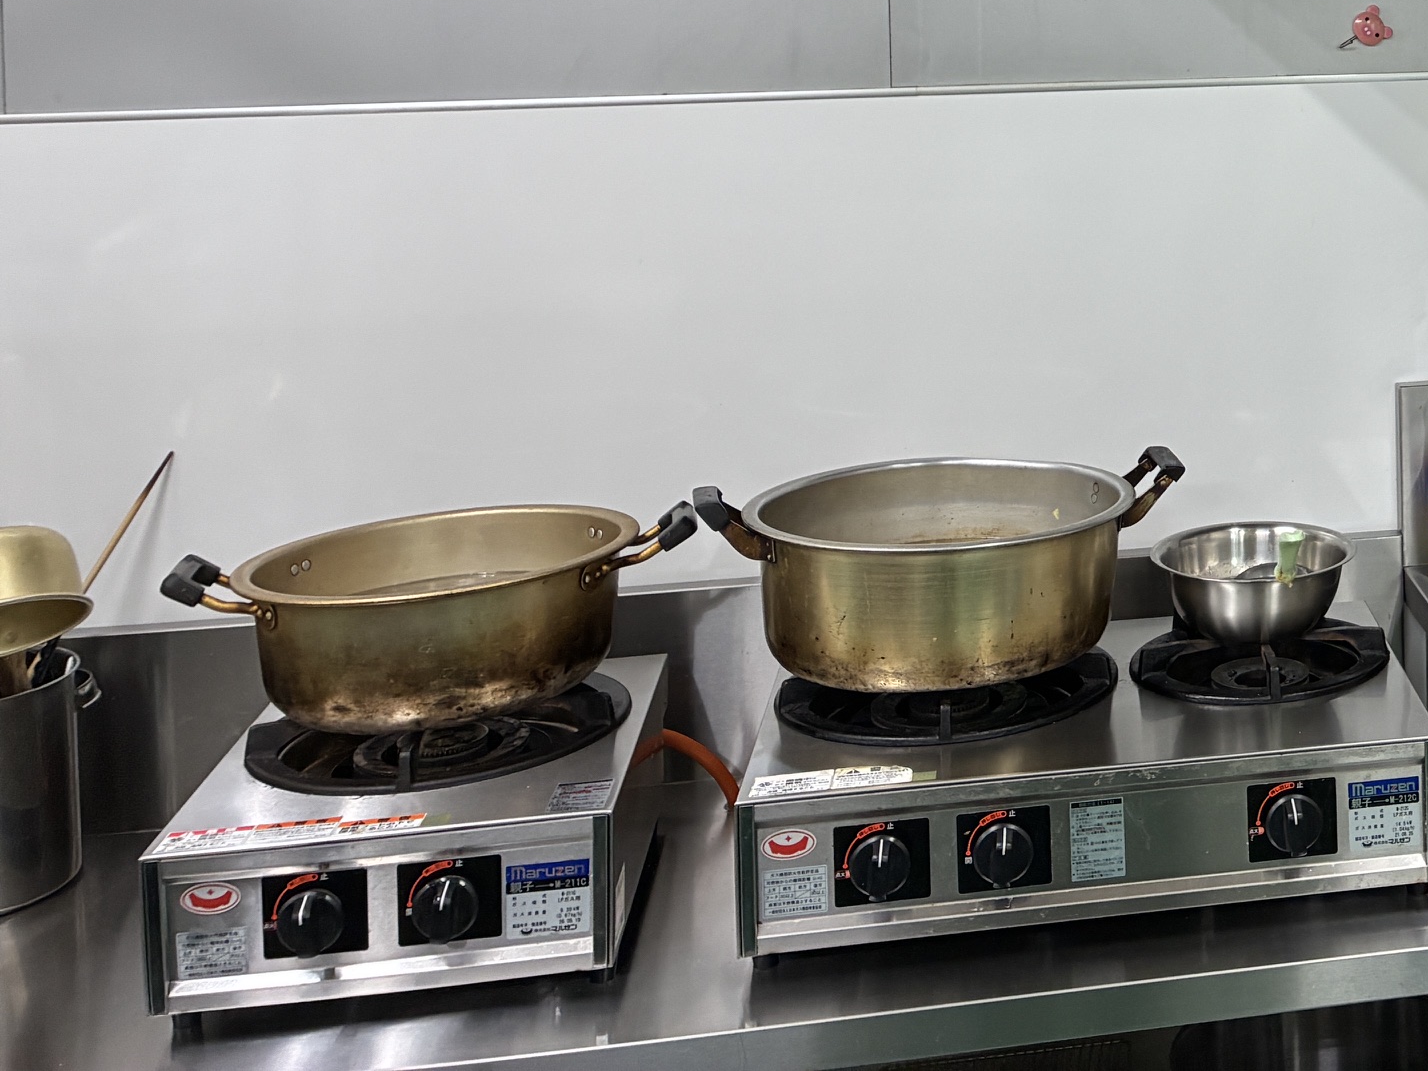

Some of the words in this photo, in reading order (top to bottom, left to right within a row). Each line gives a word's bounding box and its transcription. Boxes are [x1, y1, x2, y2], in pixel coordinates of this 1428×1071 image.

[1296, 781, 1304, 789] 止
[1352, 781, 1416, 797] Maruzen
[1009, 809, 1017, 817] 止
[886, 822, 895, 830] 止
[455, 859, 464, 868] 止
[510, 864, 586, 881] Maruzen
[320, 873, 330, 882] 止
